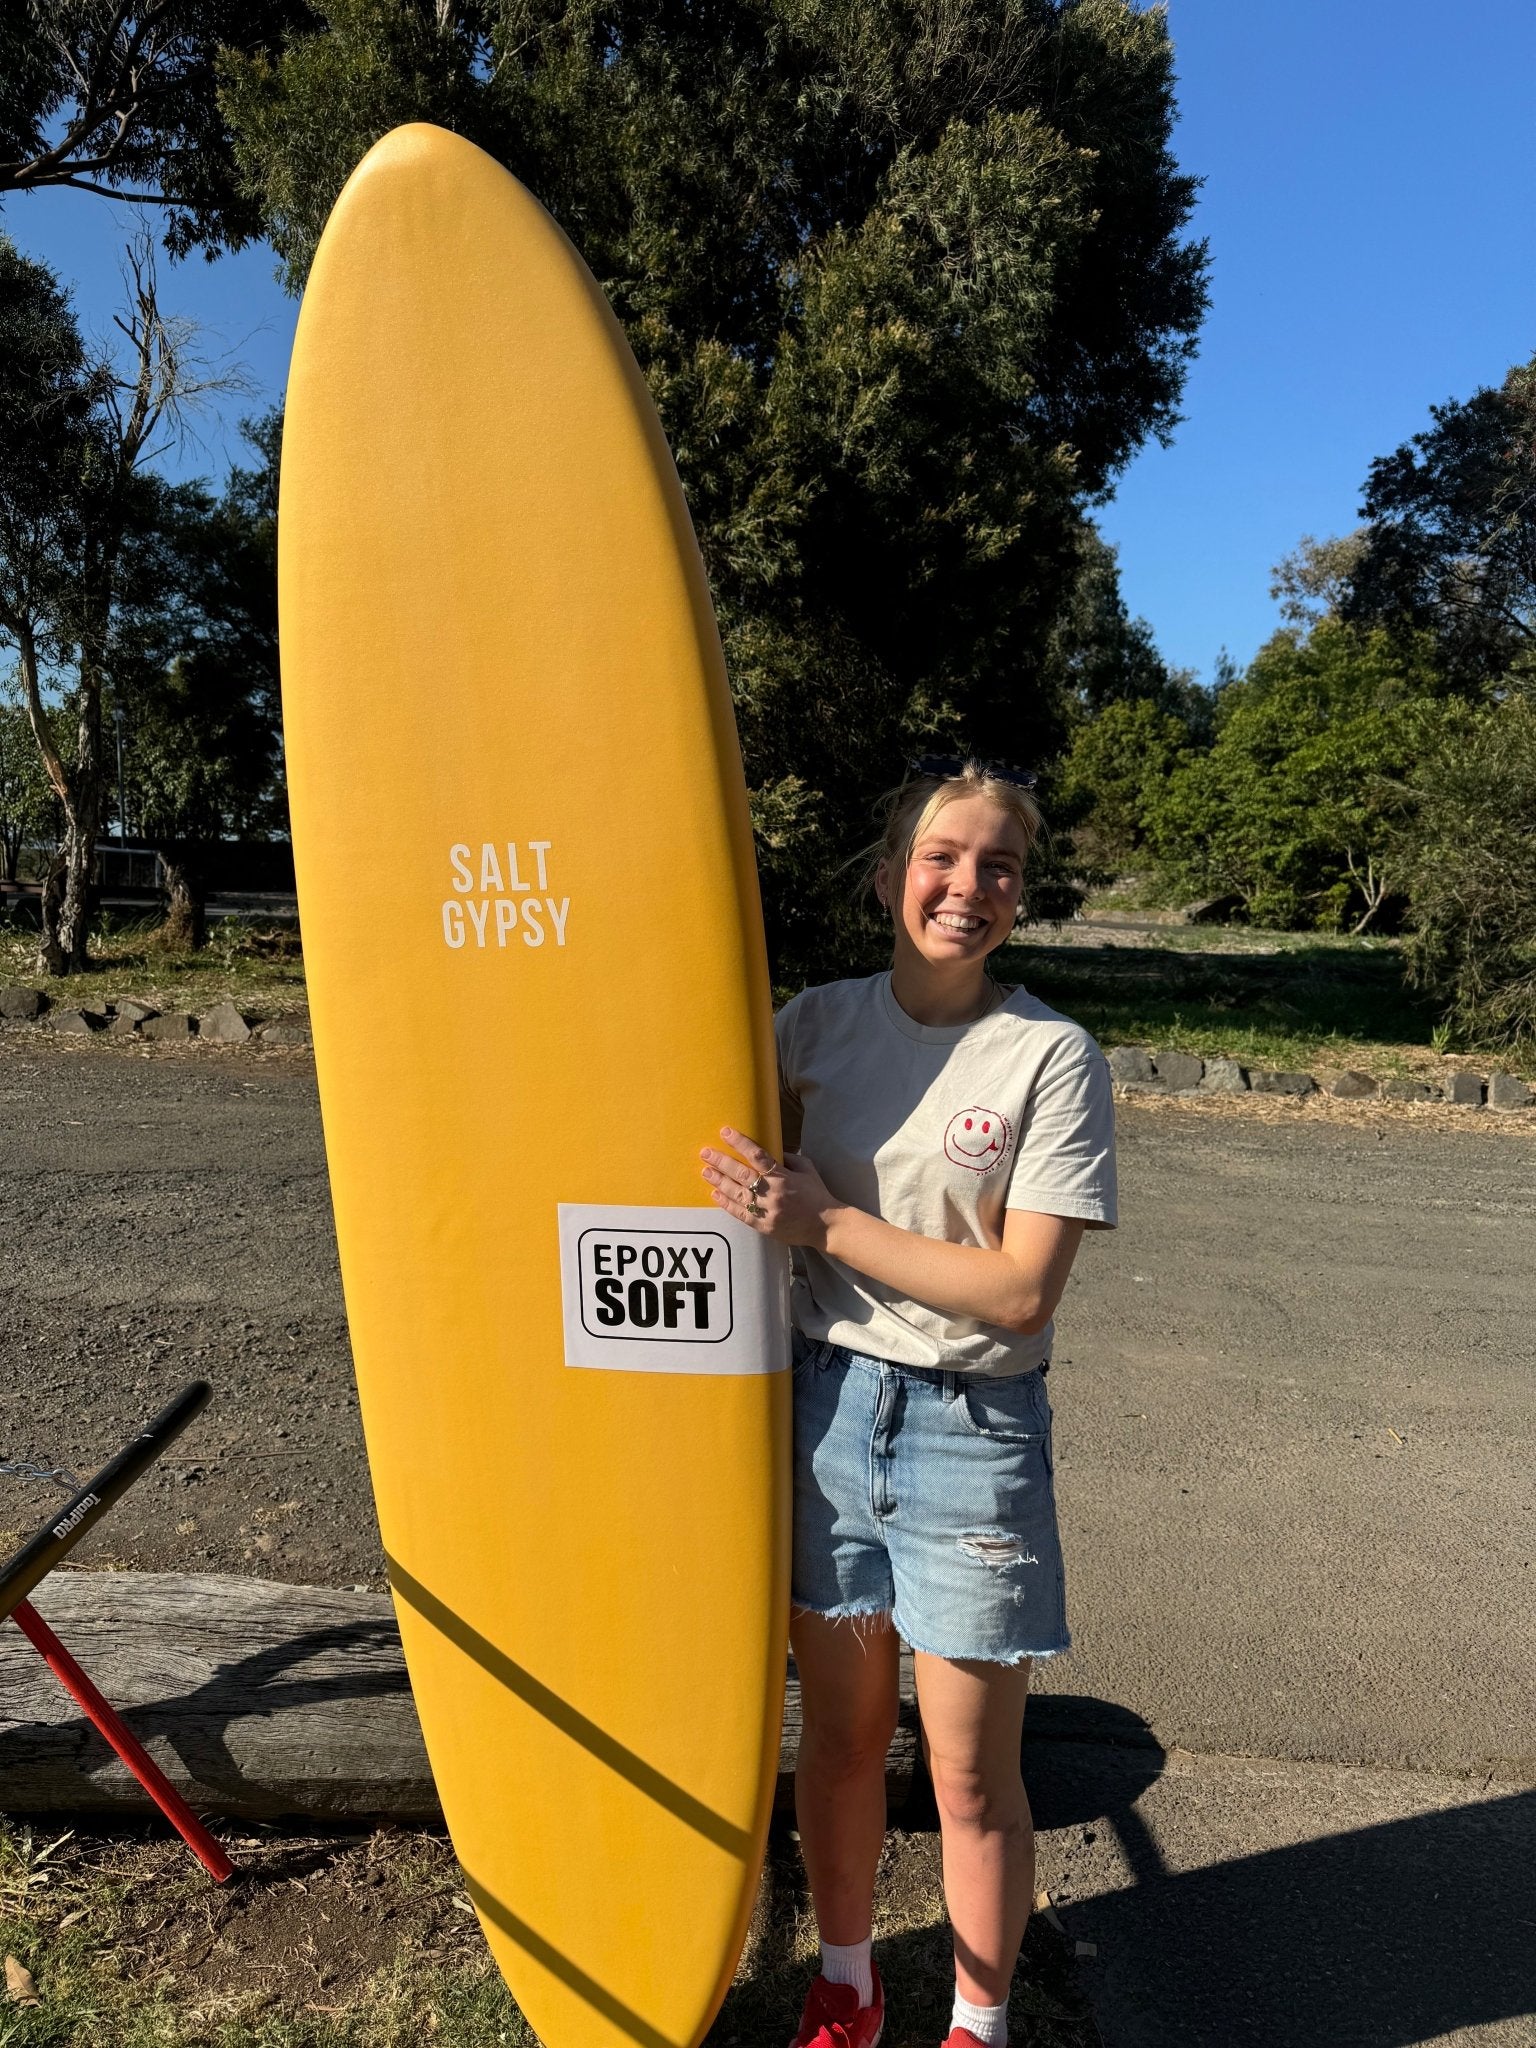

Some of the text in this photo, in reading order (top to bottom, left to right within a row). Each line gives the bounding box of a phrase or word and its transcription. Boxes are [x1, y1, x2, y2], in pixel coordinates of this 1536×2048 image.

[450, 841, 552, 893] SALT
[442, 897, 570, 949] GYPSY
[593, 1243, 714, 1279] EPOXY
[594, 1277, 716, 1330] SOFT
[52, 1492, 102, 1540] ToolPRO
